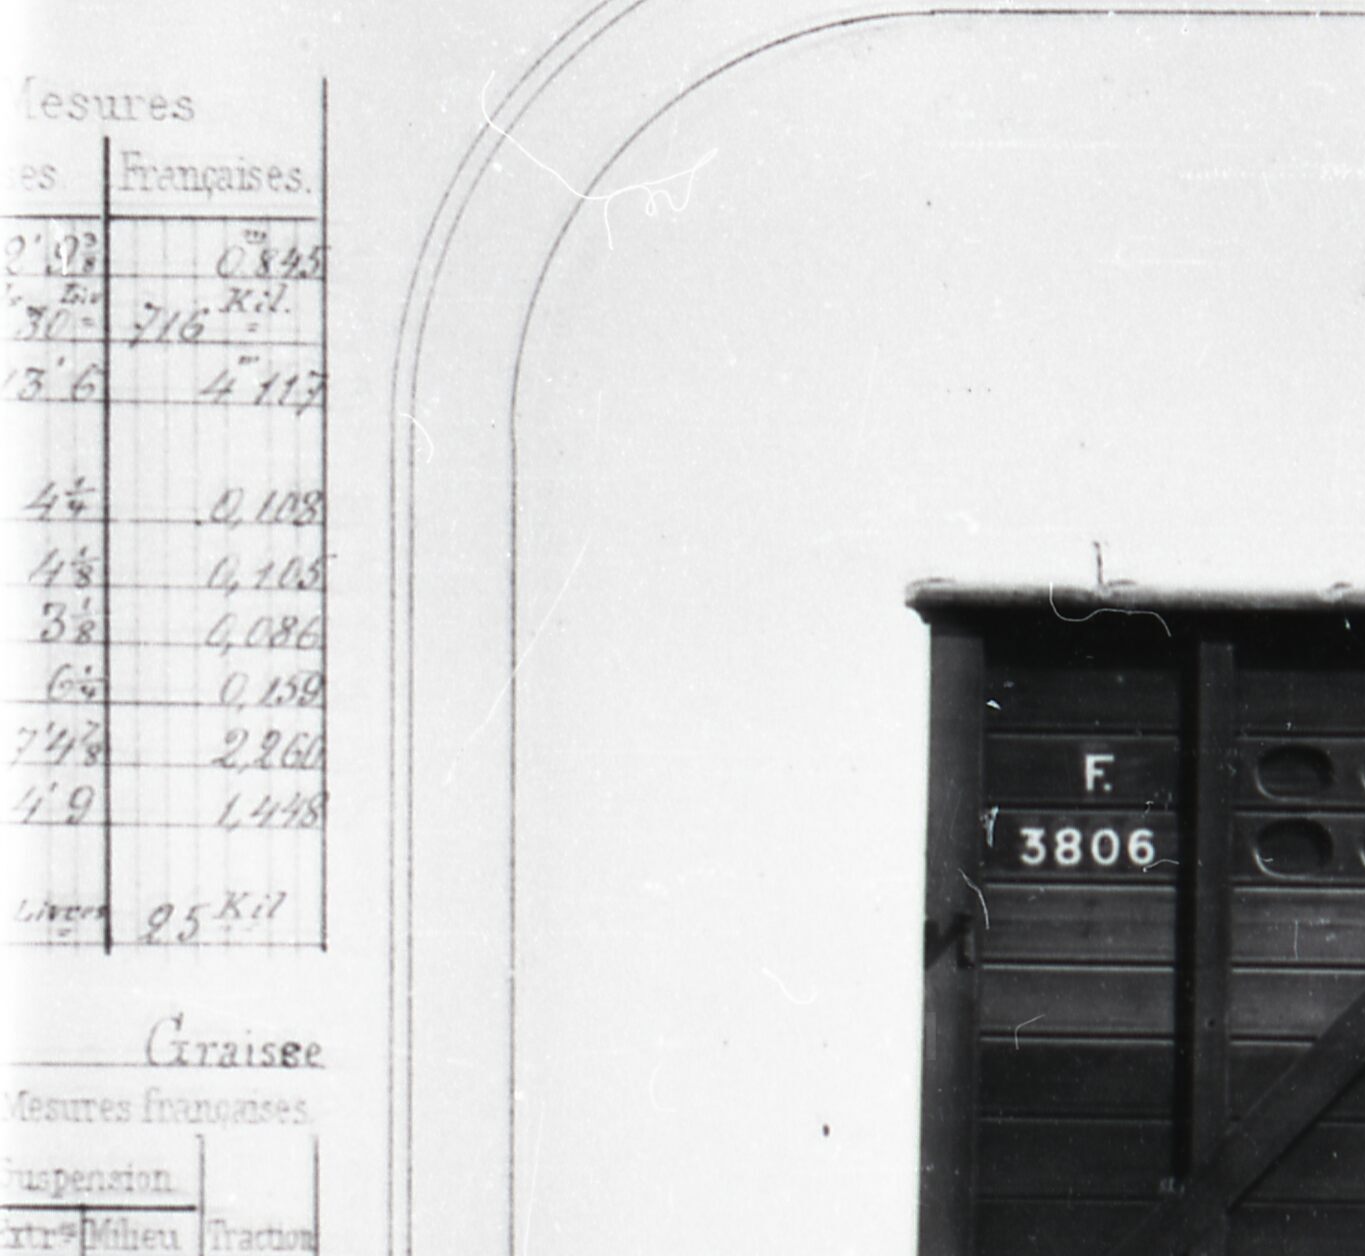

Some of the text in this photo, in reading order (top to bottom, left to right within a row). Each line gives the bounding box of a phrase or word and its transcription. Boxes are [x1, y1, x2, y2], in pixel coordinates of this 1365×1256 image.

[22, 76, 197, 121] esures
[1084, 754, 1115, 791] F.
[1019, 828, 1155, 866] 3806
